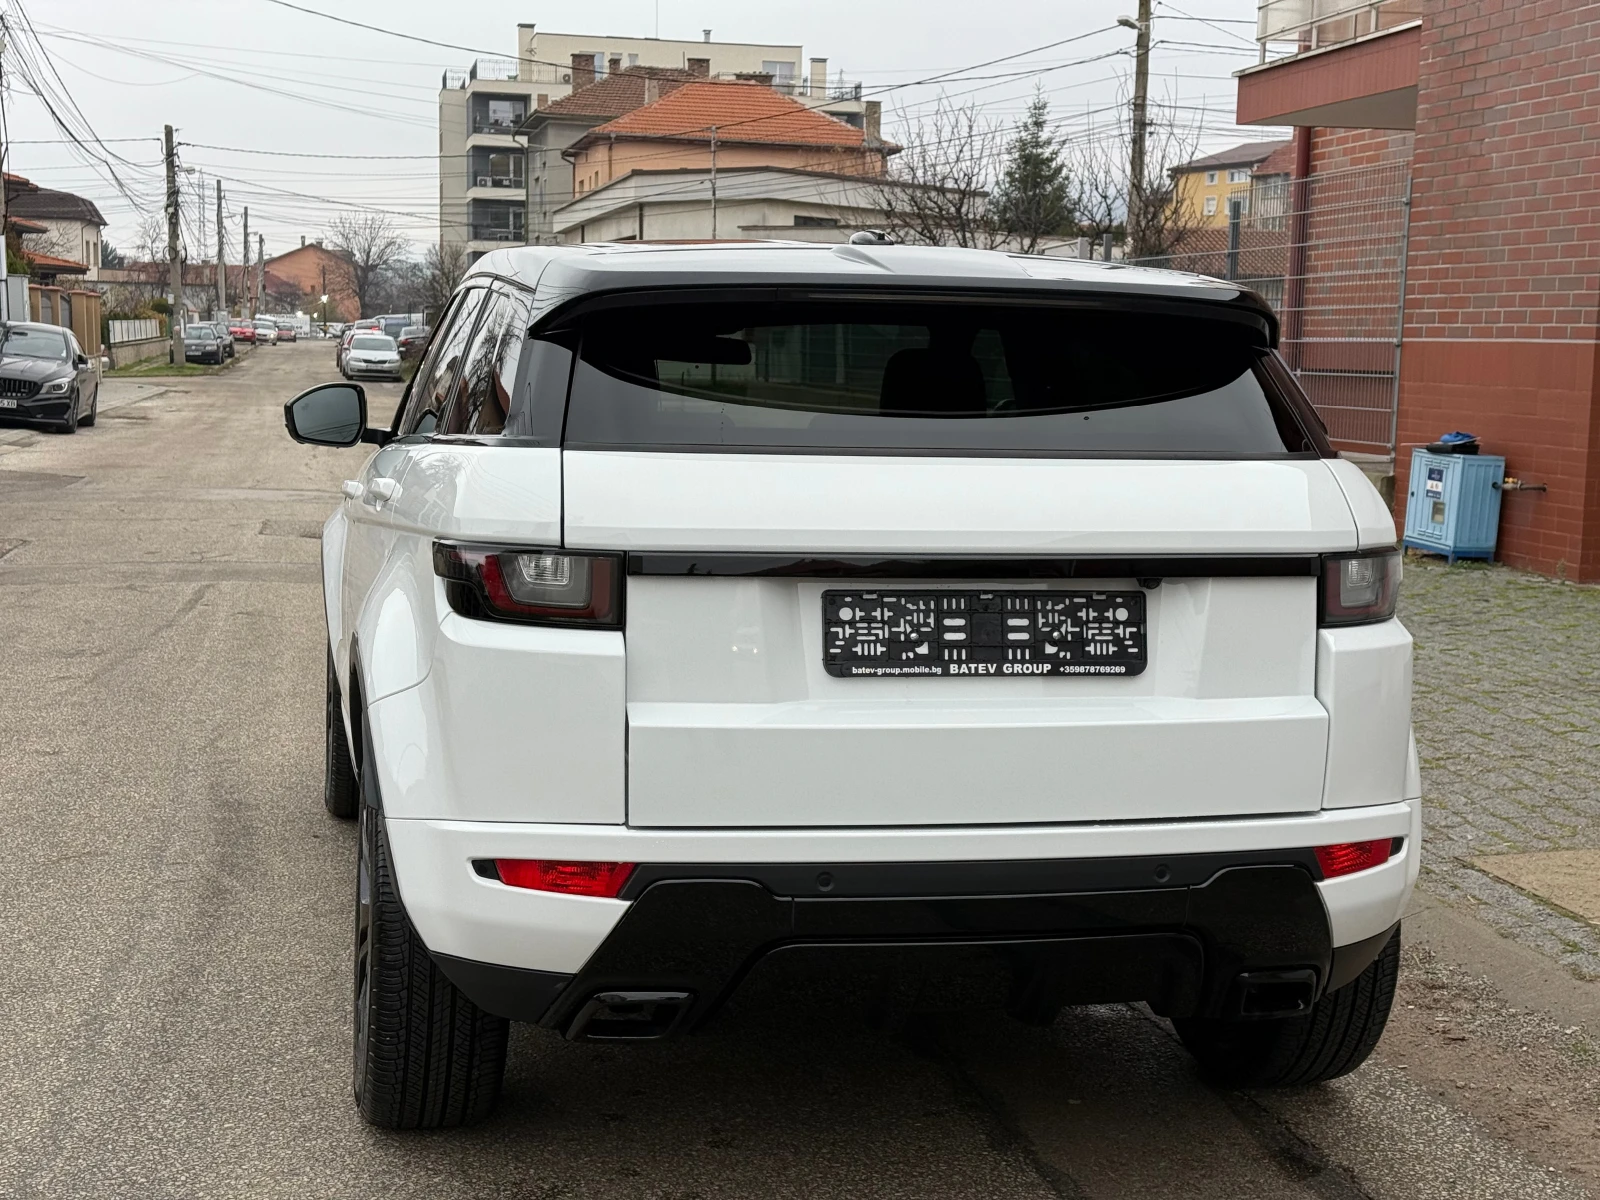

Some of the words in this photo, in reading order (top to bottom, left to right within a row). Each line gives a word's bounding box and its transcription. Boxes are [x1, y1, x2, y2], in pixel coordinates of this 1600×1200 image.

[852, 666, 942, 675] batev-group.mobile.bg
[949, 663, 997, 674] BATEV
[1002, 663, 1052, 674] GROUP
[1059, 665, 1126, 673] +359878769269
